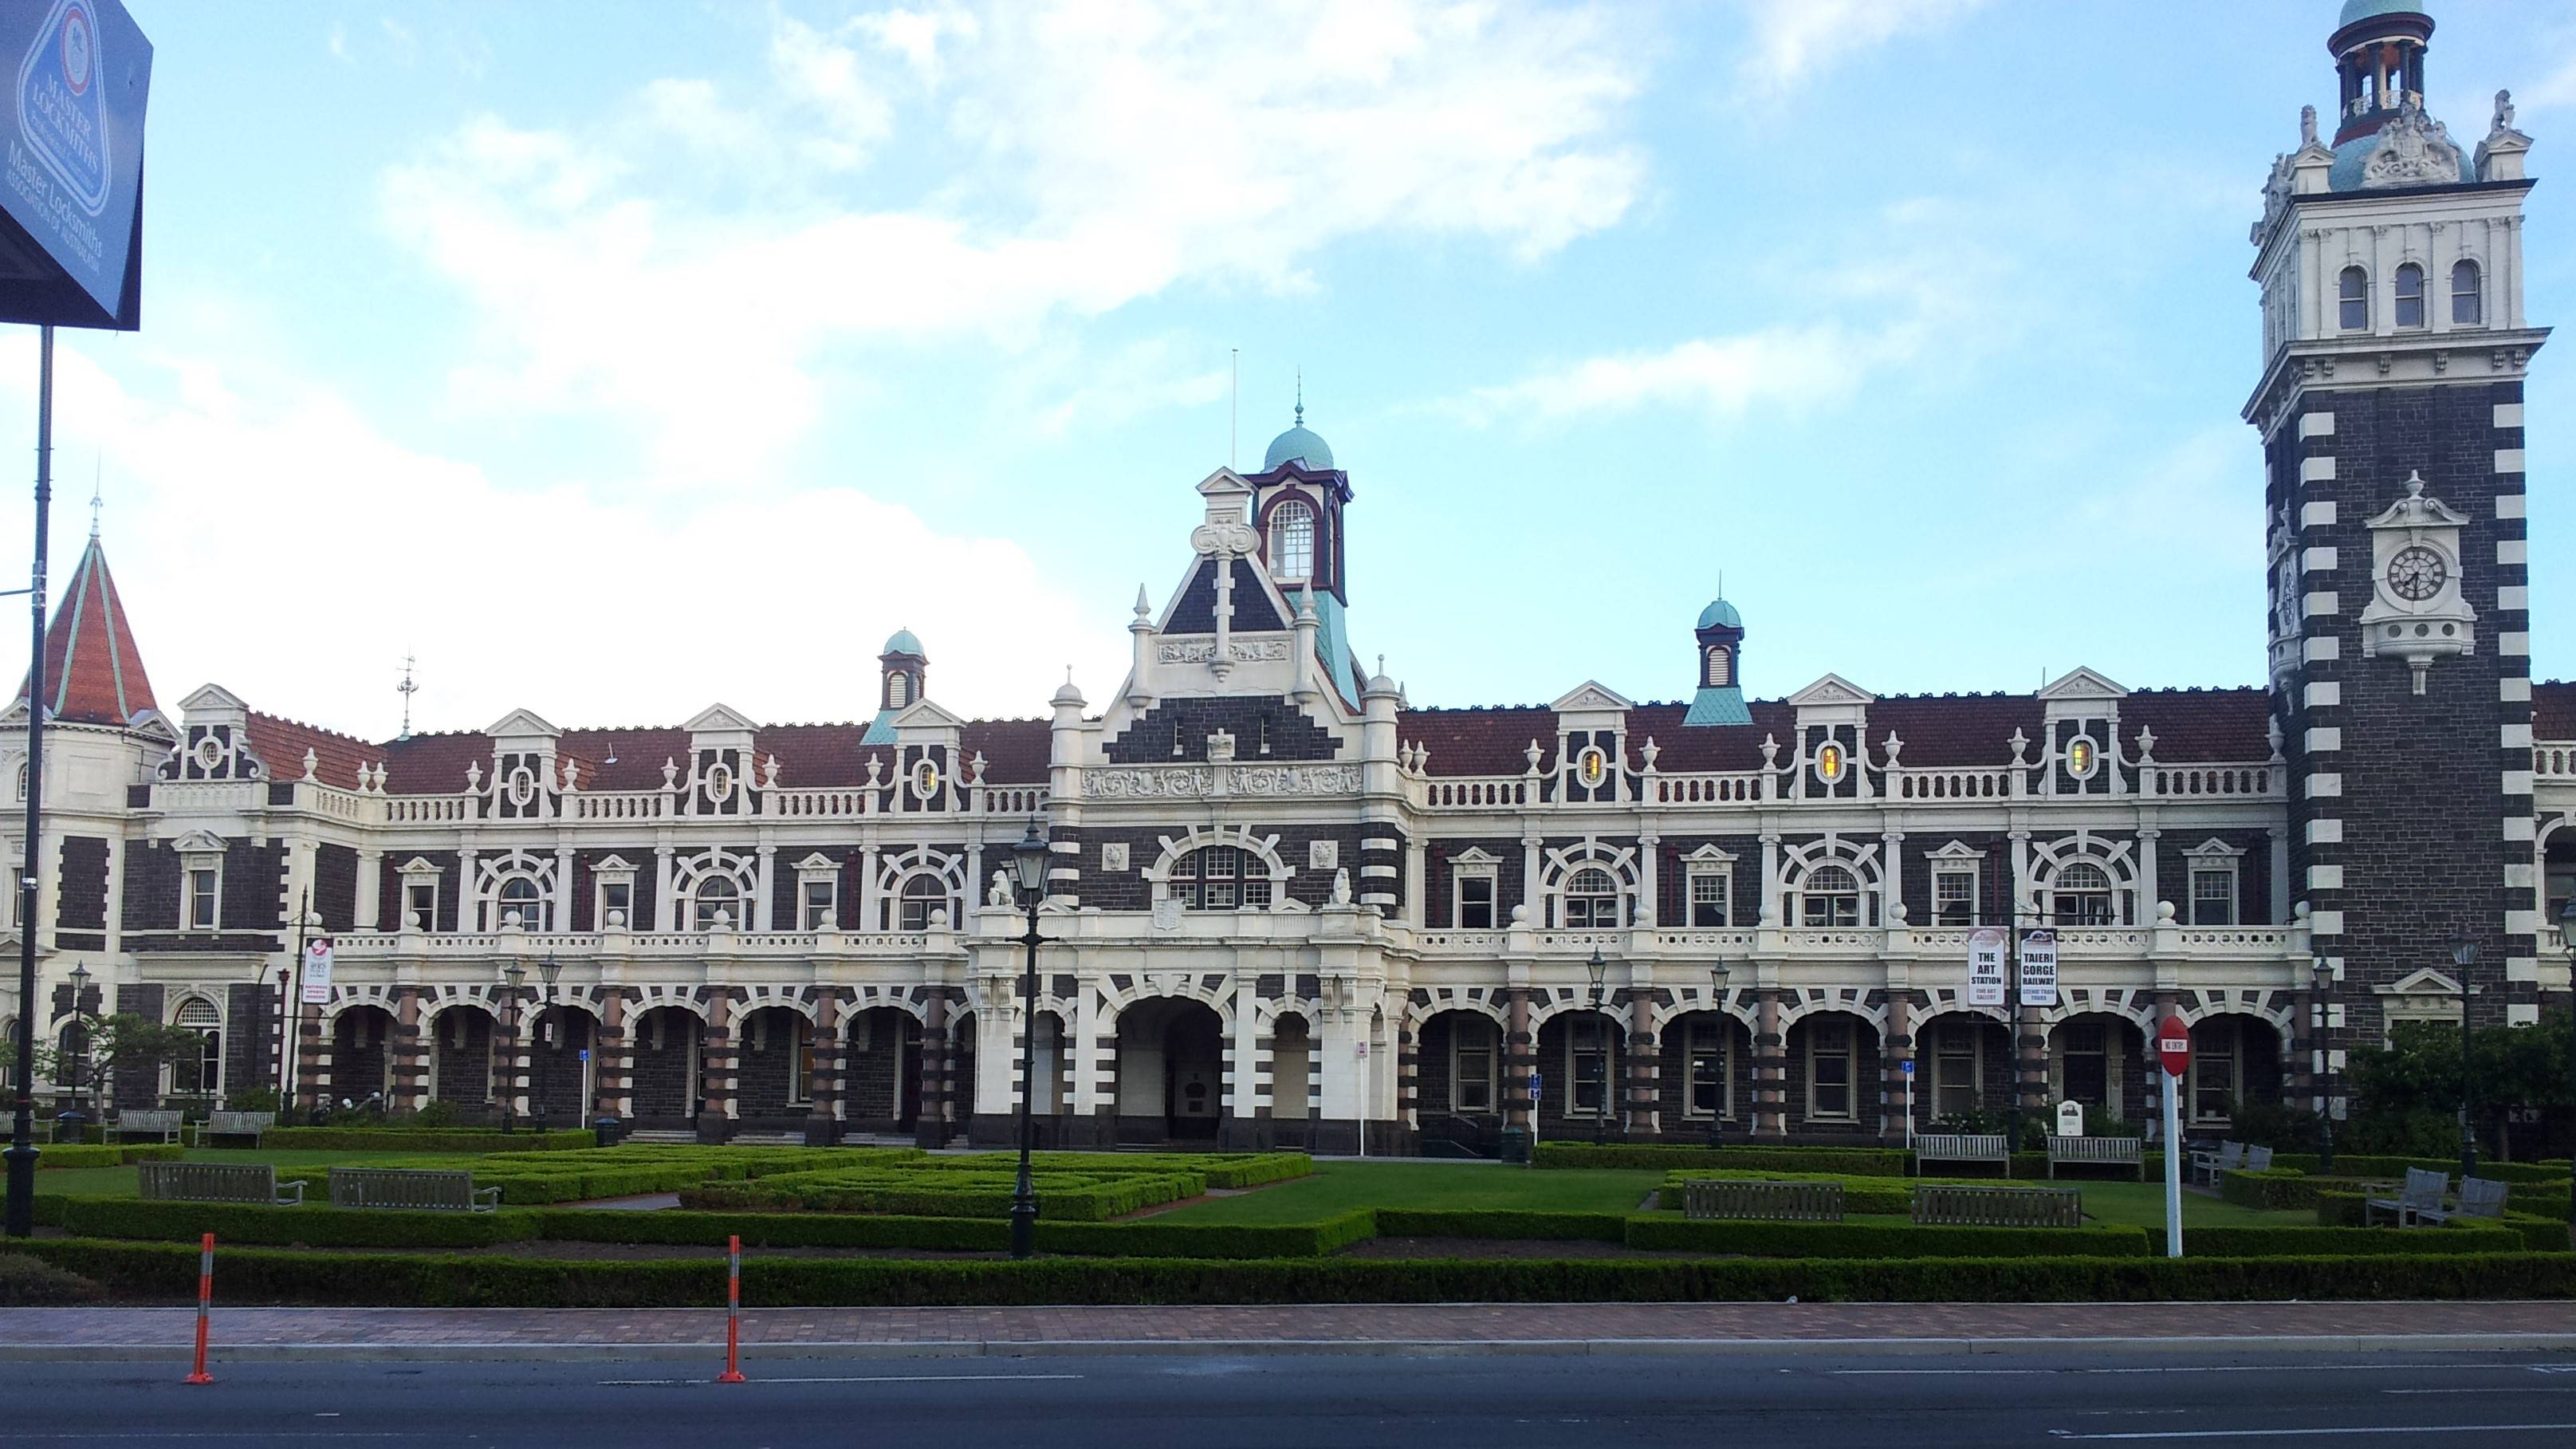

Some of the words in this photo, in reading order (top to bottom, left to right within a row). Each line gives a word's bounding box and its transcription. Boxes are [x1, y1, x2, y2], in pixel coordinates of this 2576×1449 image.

[47, 73, 92, 142] MASTER
[6, 168, 50, 224] ASSOCIATION
[50, 215, 61, 234] OF
[7, 139, 47, 198] Master
[49, 183, 103, 258] Locksmiths
[1978, 952, 1996, 963] THE
[2023, 953, 2054, 963] TAIERI
[1977, 965, 1996, 975] ART
[2023, 965, 2055, 975] GORGE
[1971, 976, 2002, 985] STATION
